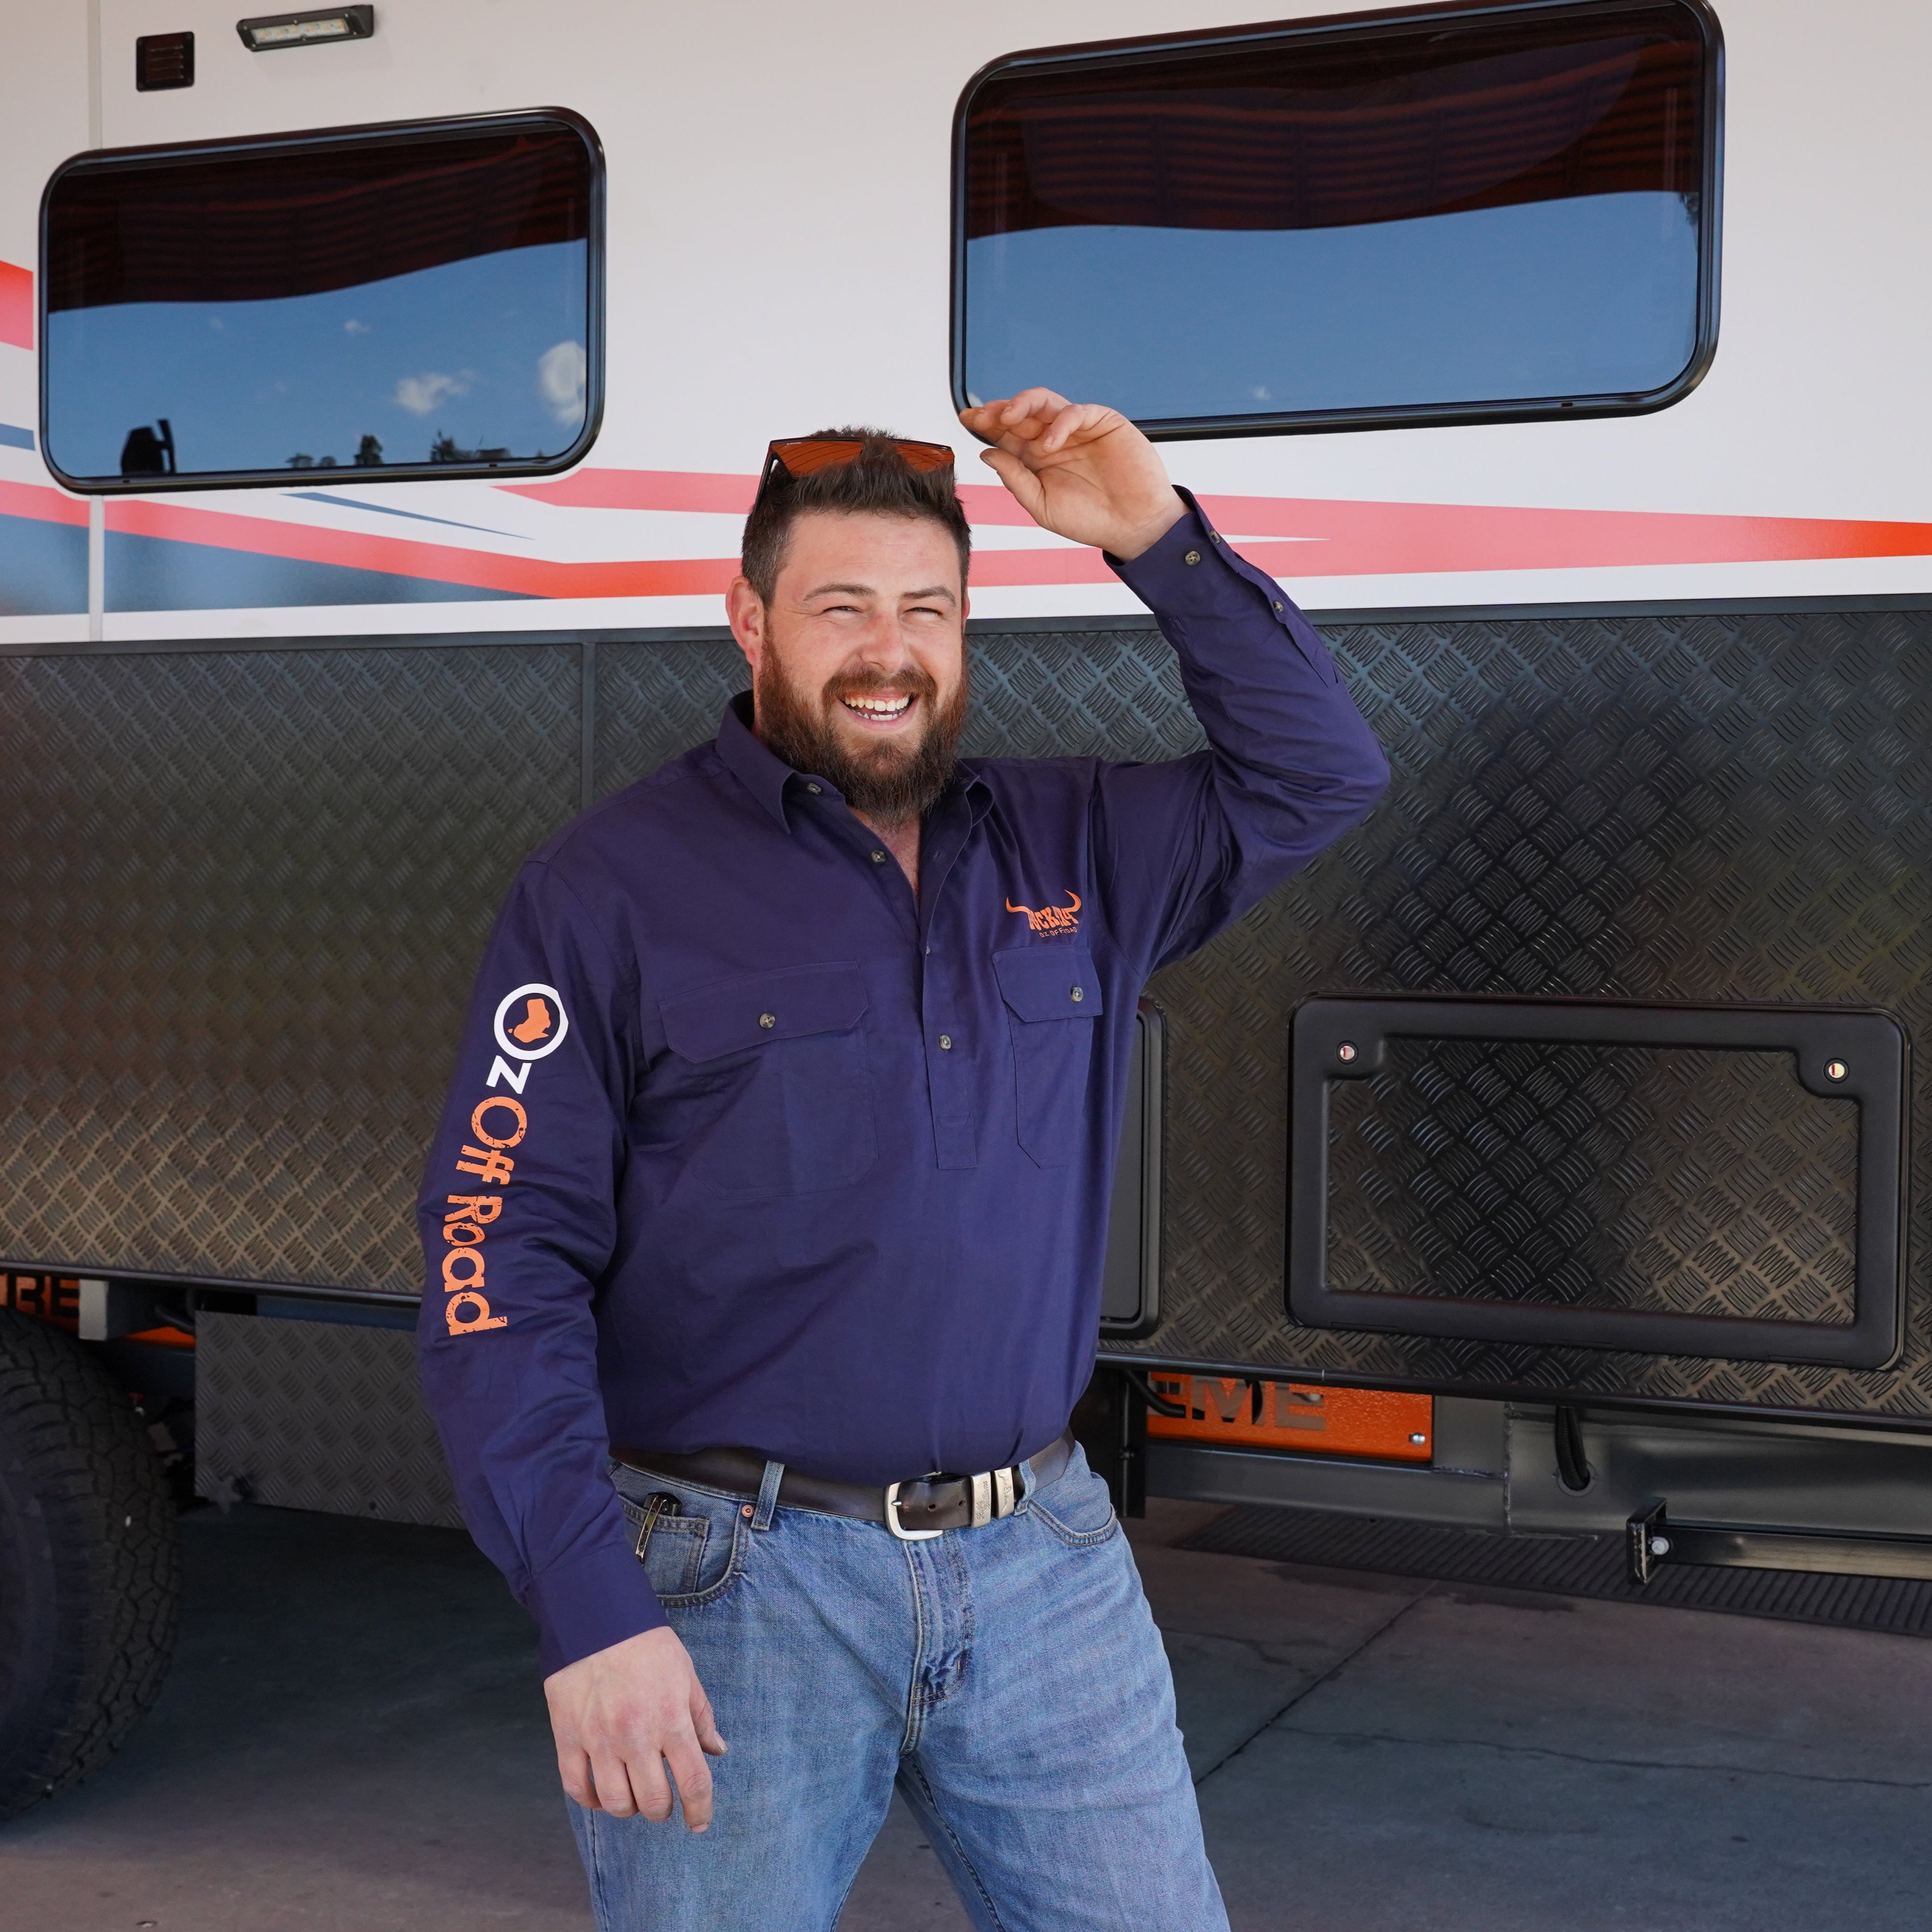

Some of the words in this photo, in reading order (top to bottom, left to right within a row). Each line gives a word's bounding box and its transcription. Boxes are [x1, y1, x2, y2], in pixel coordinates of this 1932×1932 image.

[1050, 927, 1063, 936] OFF
[486, 983, 568, 1094] OZ
[455, 1096, 527, 1185] Off
[442, 1194, 508, 1335] Road
